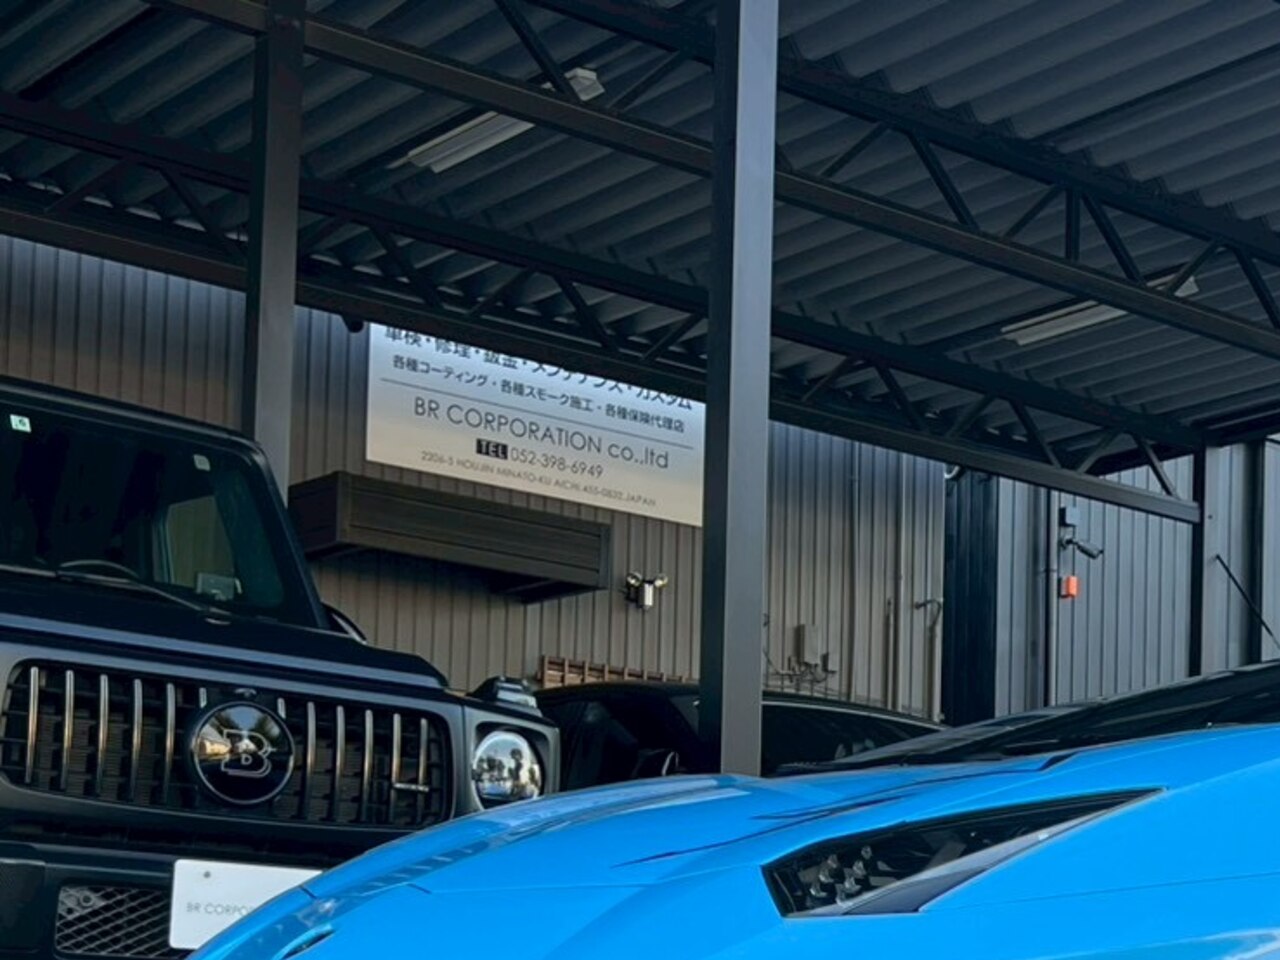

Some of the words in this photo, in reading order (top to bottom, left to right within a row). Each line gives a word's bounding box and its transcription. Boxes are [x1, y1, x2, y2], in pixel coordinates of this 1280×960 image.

[414, 396, 440, 420] BR
[446, 403, 602, 454] CORPORATION
[479, 440, 506, 460] TEL
[510, 446, 604, 478] 052-398-6949
[186, 902, 201, 914] BR
